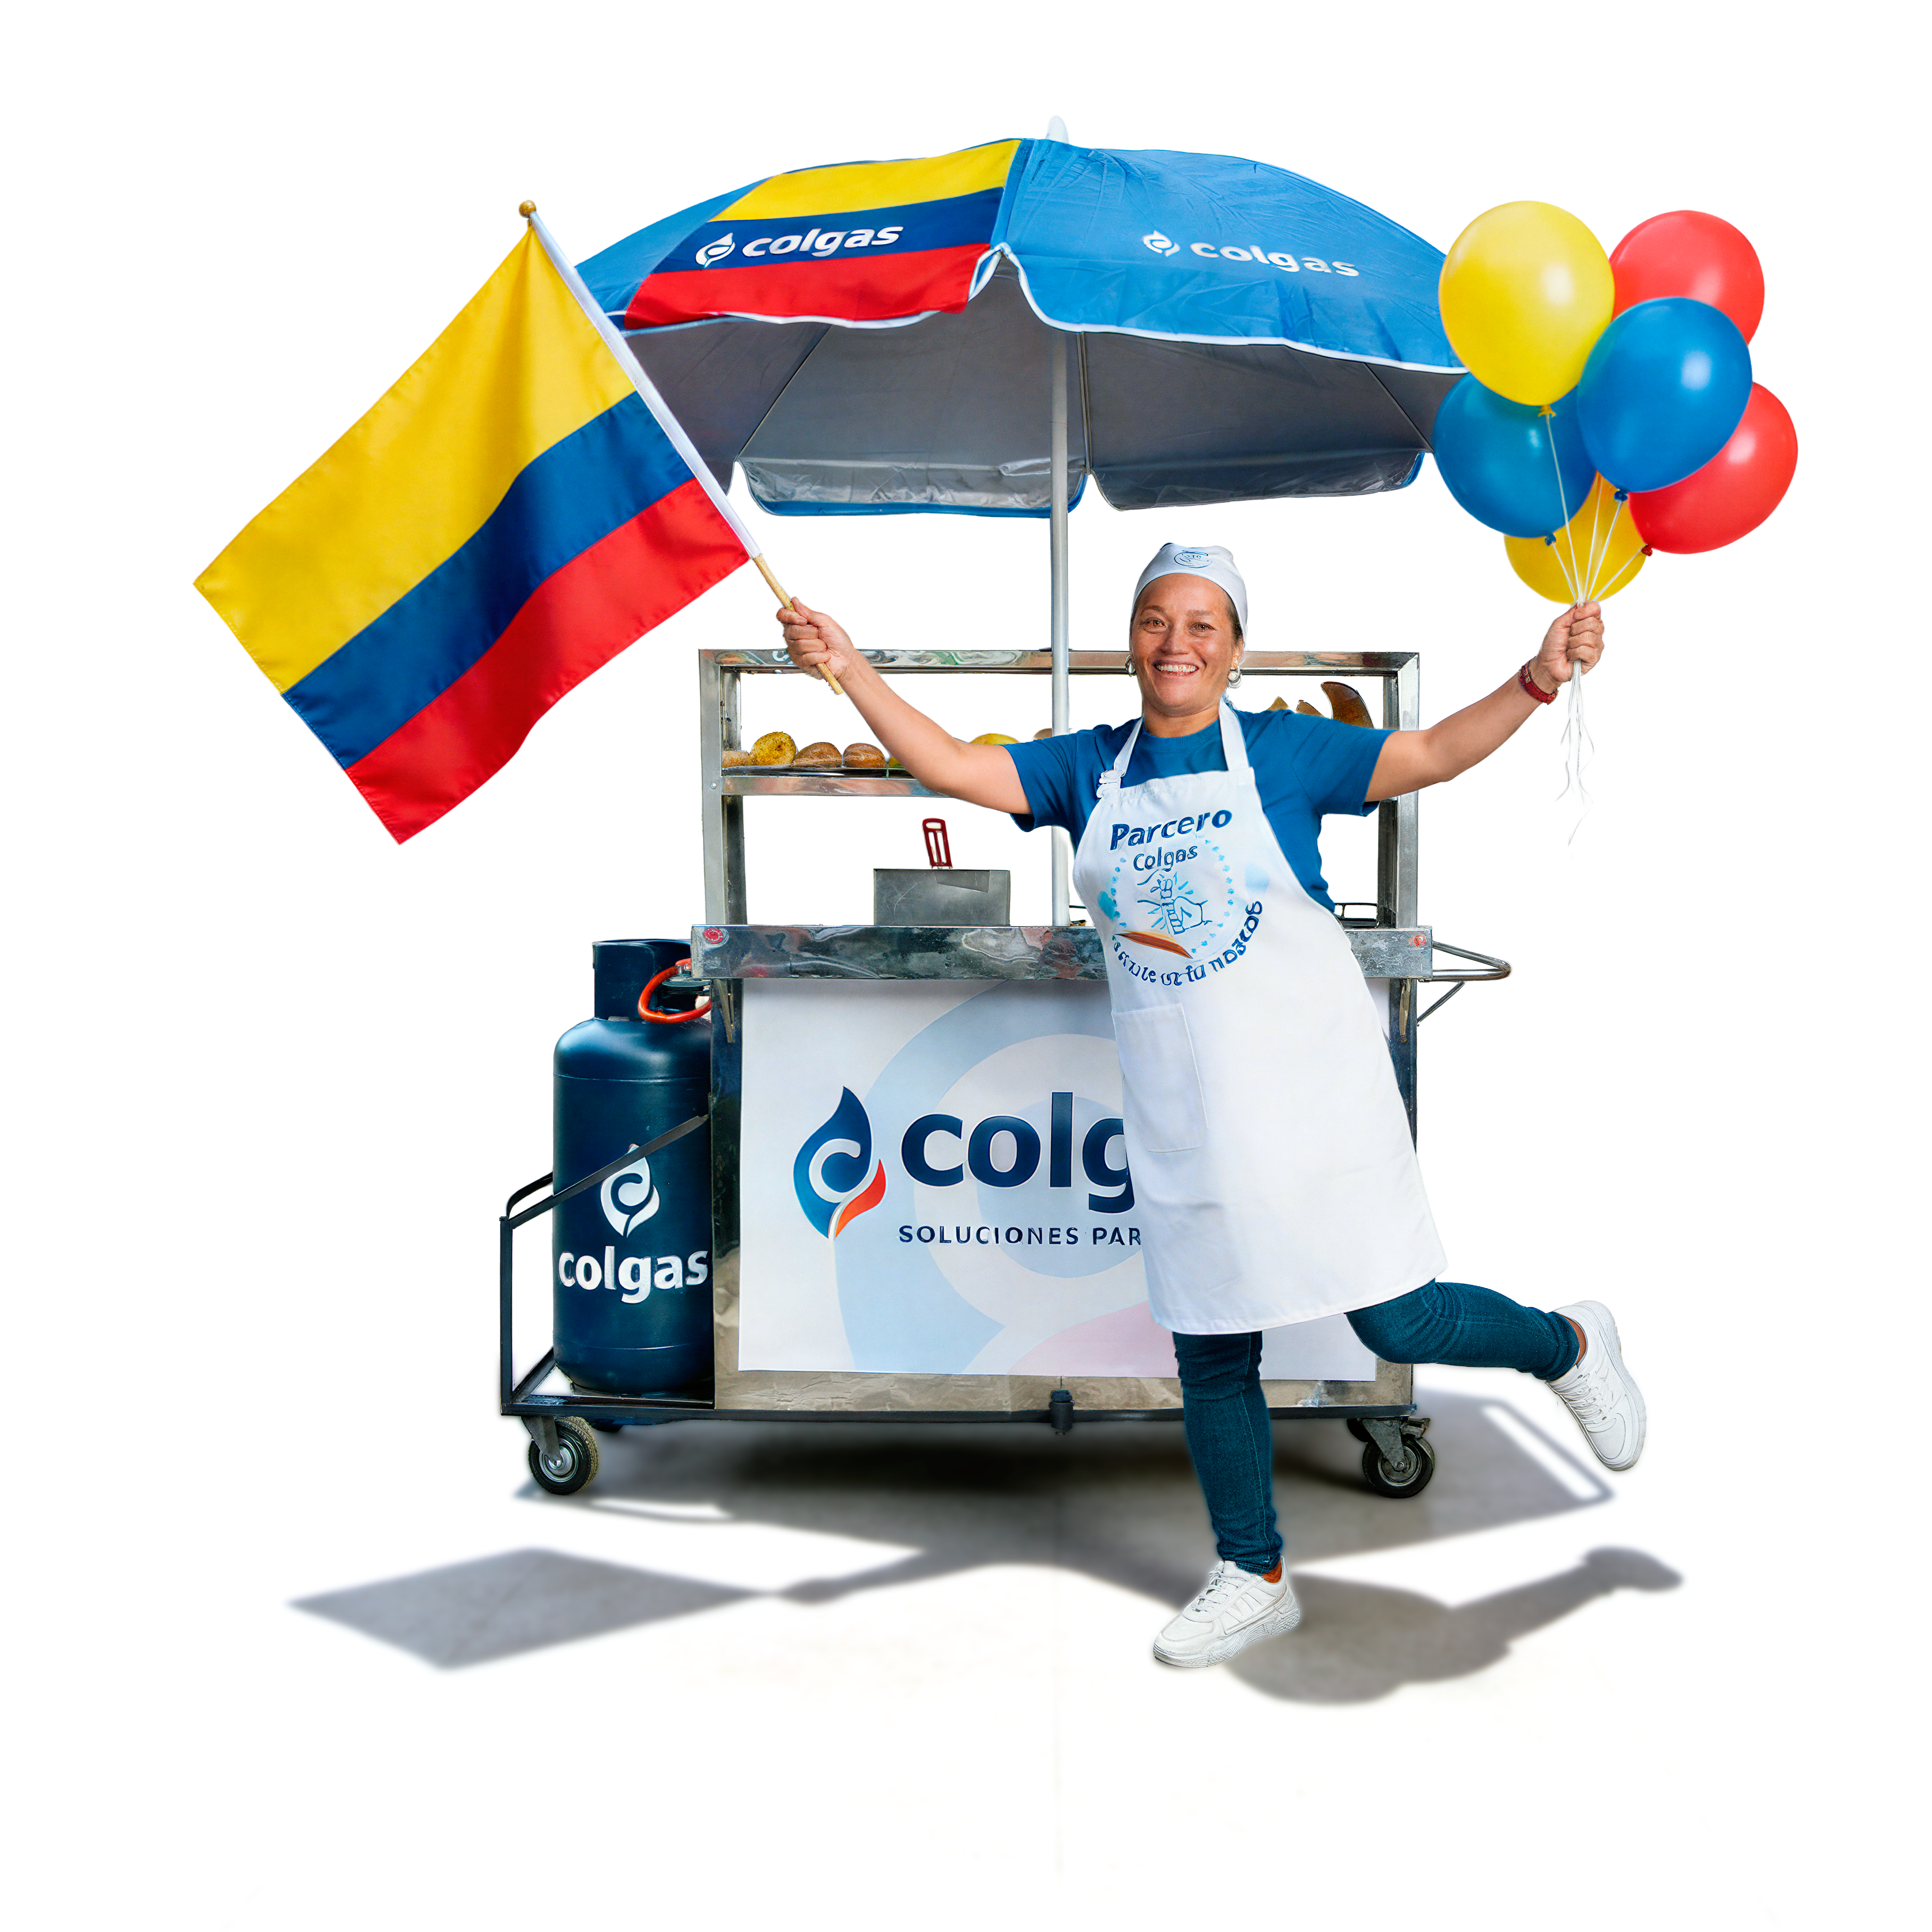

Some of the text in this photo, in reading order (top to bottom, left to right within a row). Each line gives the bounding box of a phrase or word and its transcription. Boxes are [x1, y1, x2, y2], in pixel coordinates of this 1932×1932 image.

[742, 226, 903, 257] colgas
[1190, 242, 1360, 277] colgas
[1110, 809, 1232, 850] Parcero
[901, 1091, 1135, 1214] colg
[899, 1225, 1141, 1246] SOLUCIONES PAR
[559, 1245, 708, 1304] colgas
